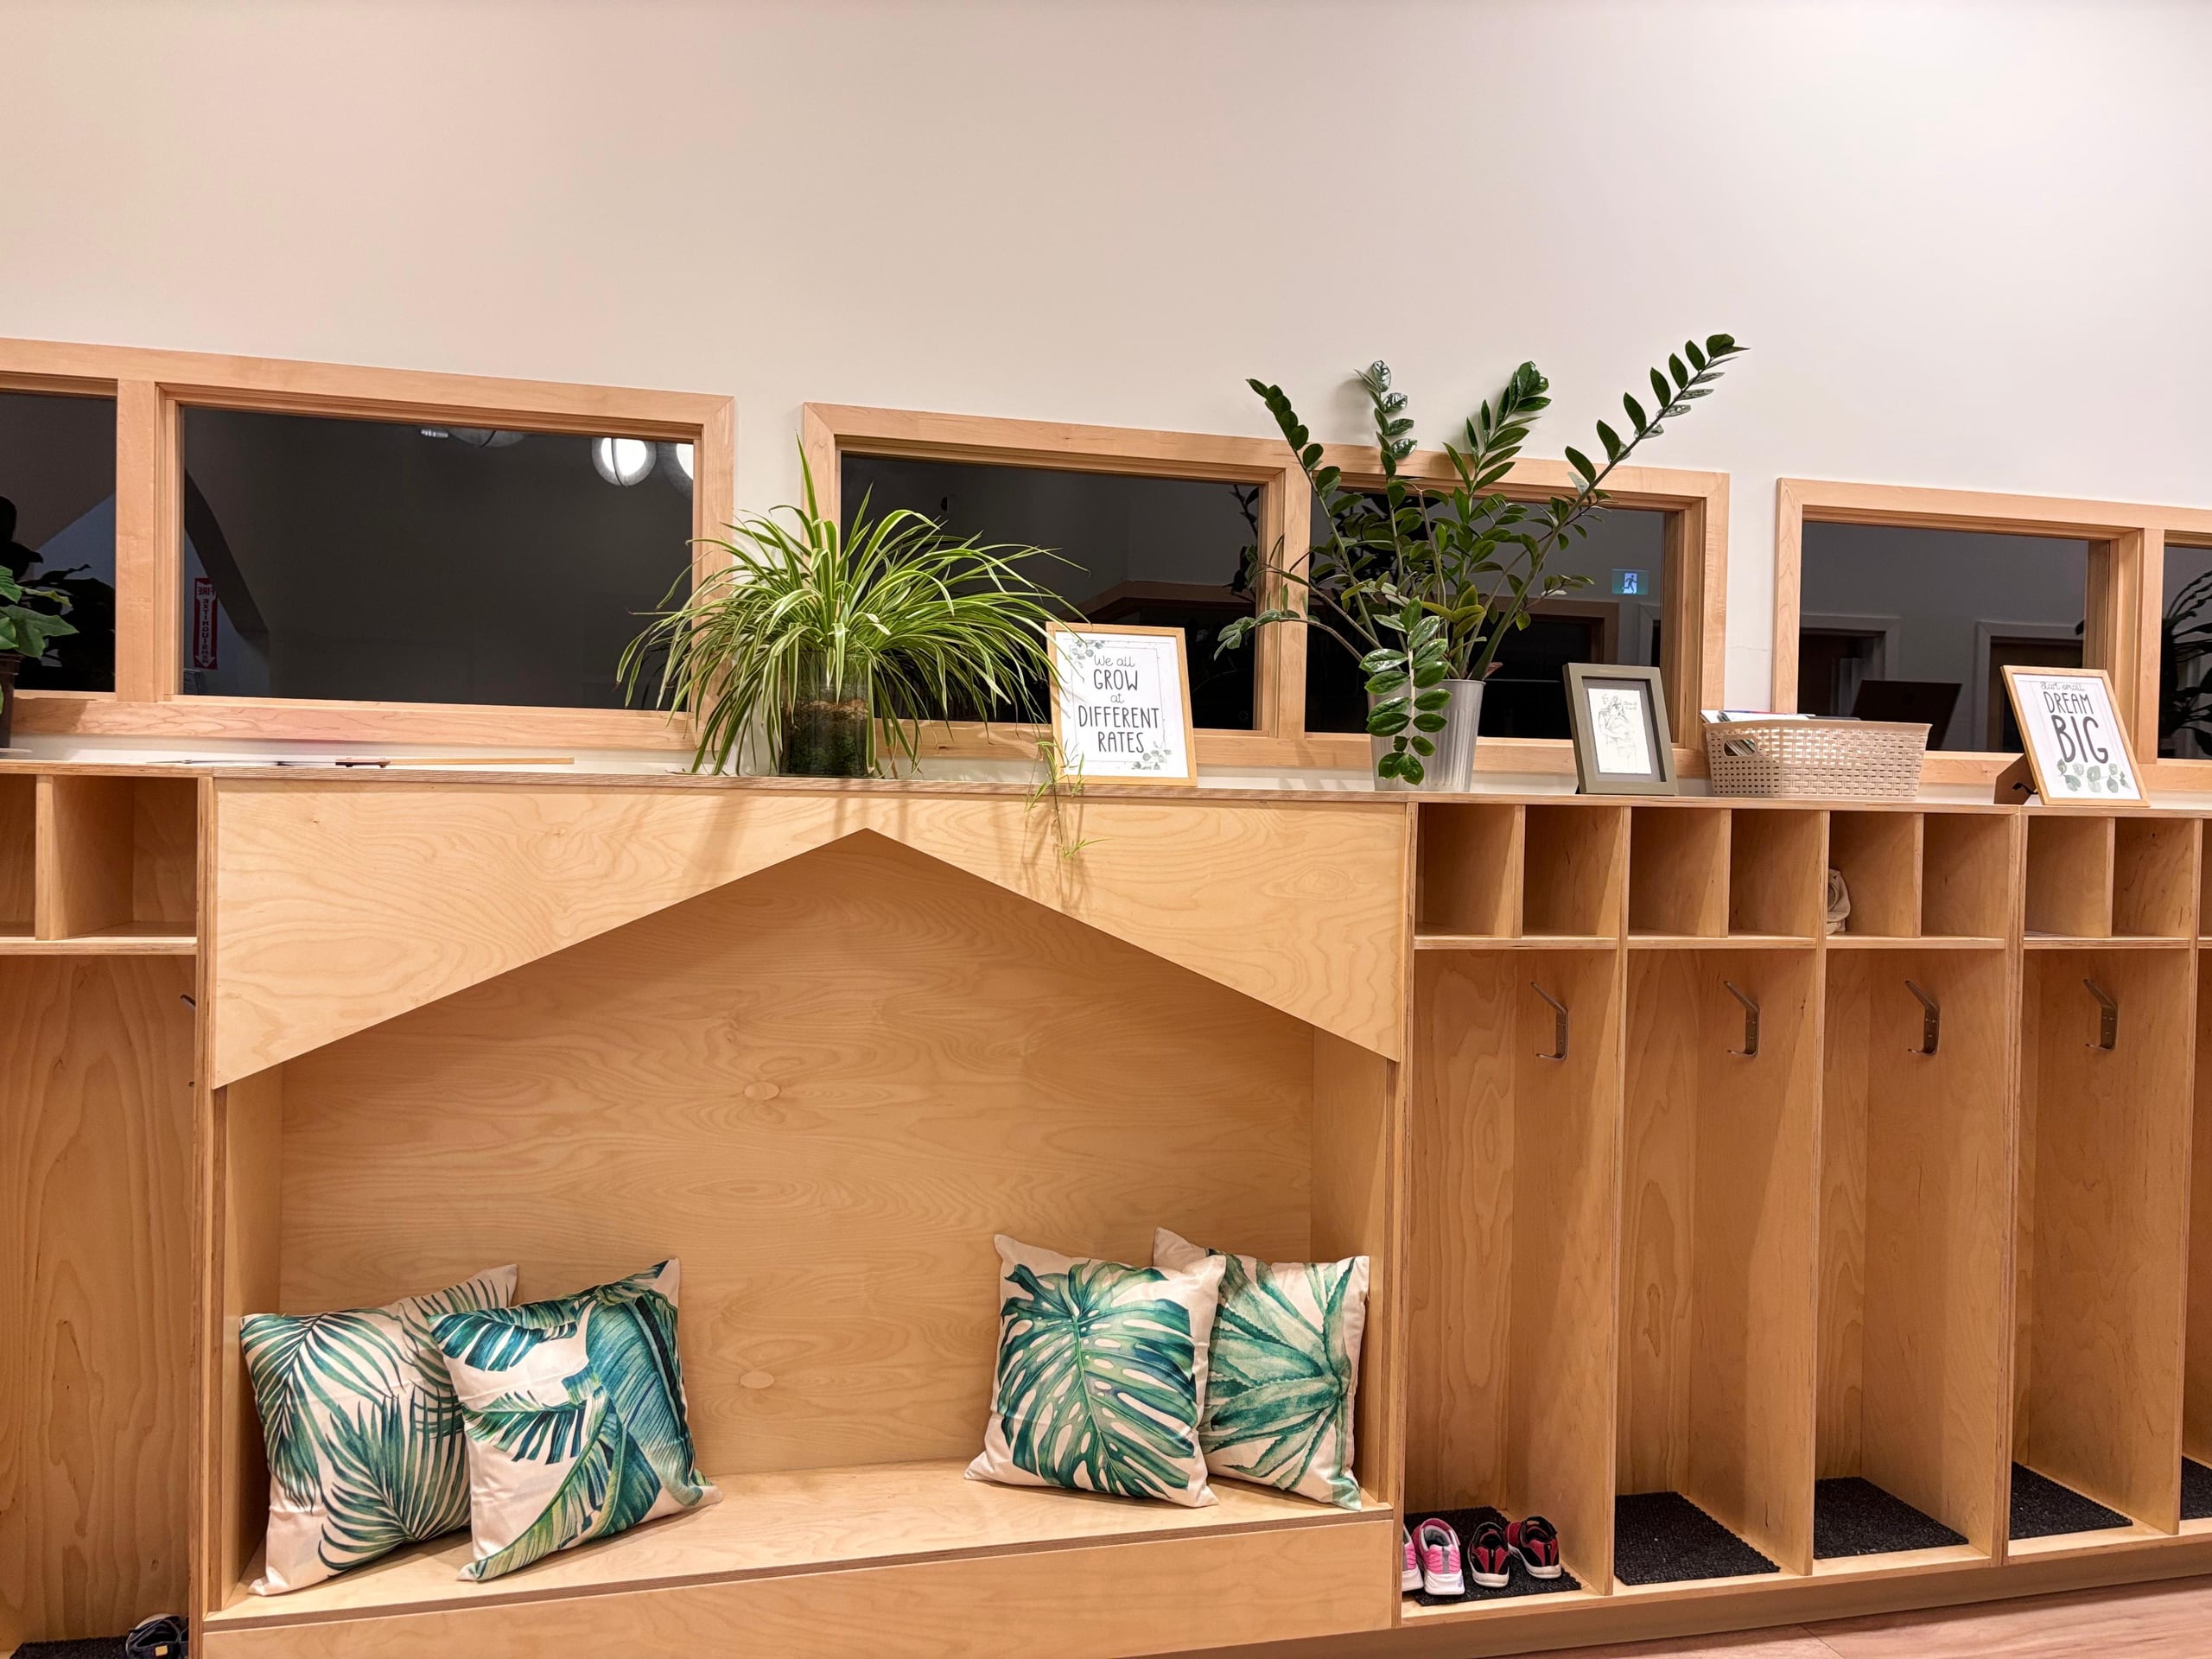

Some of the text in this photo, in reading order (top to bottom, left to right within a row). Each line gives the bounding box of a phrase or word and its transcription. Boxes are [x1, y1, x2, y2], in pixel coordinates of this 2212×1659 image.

[1094, 655, 1135, 668] We all
[1093, 669, 1138, 690] GROW
[1110, 693, 1125, 704] at
[2044, 691, 2094, 715] DREAM
[1078, 705, 1160, 728] DIFFERENT
[1097, 731, 1144, 753] RATES
[2050, 715, 2108, 764] BIG
